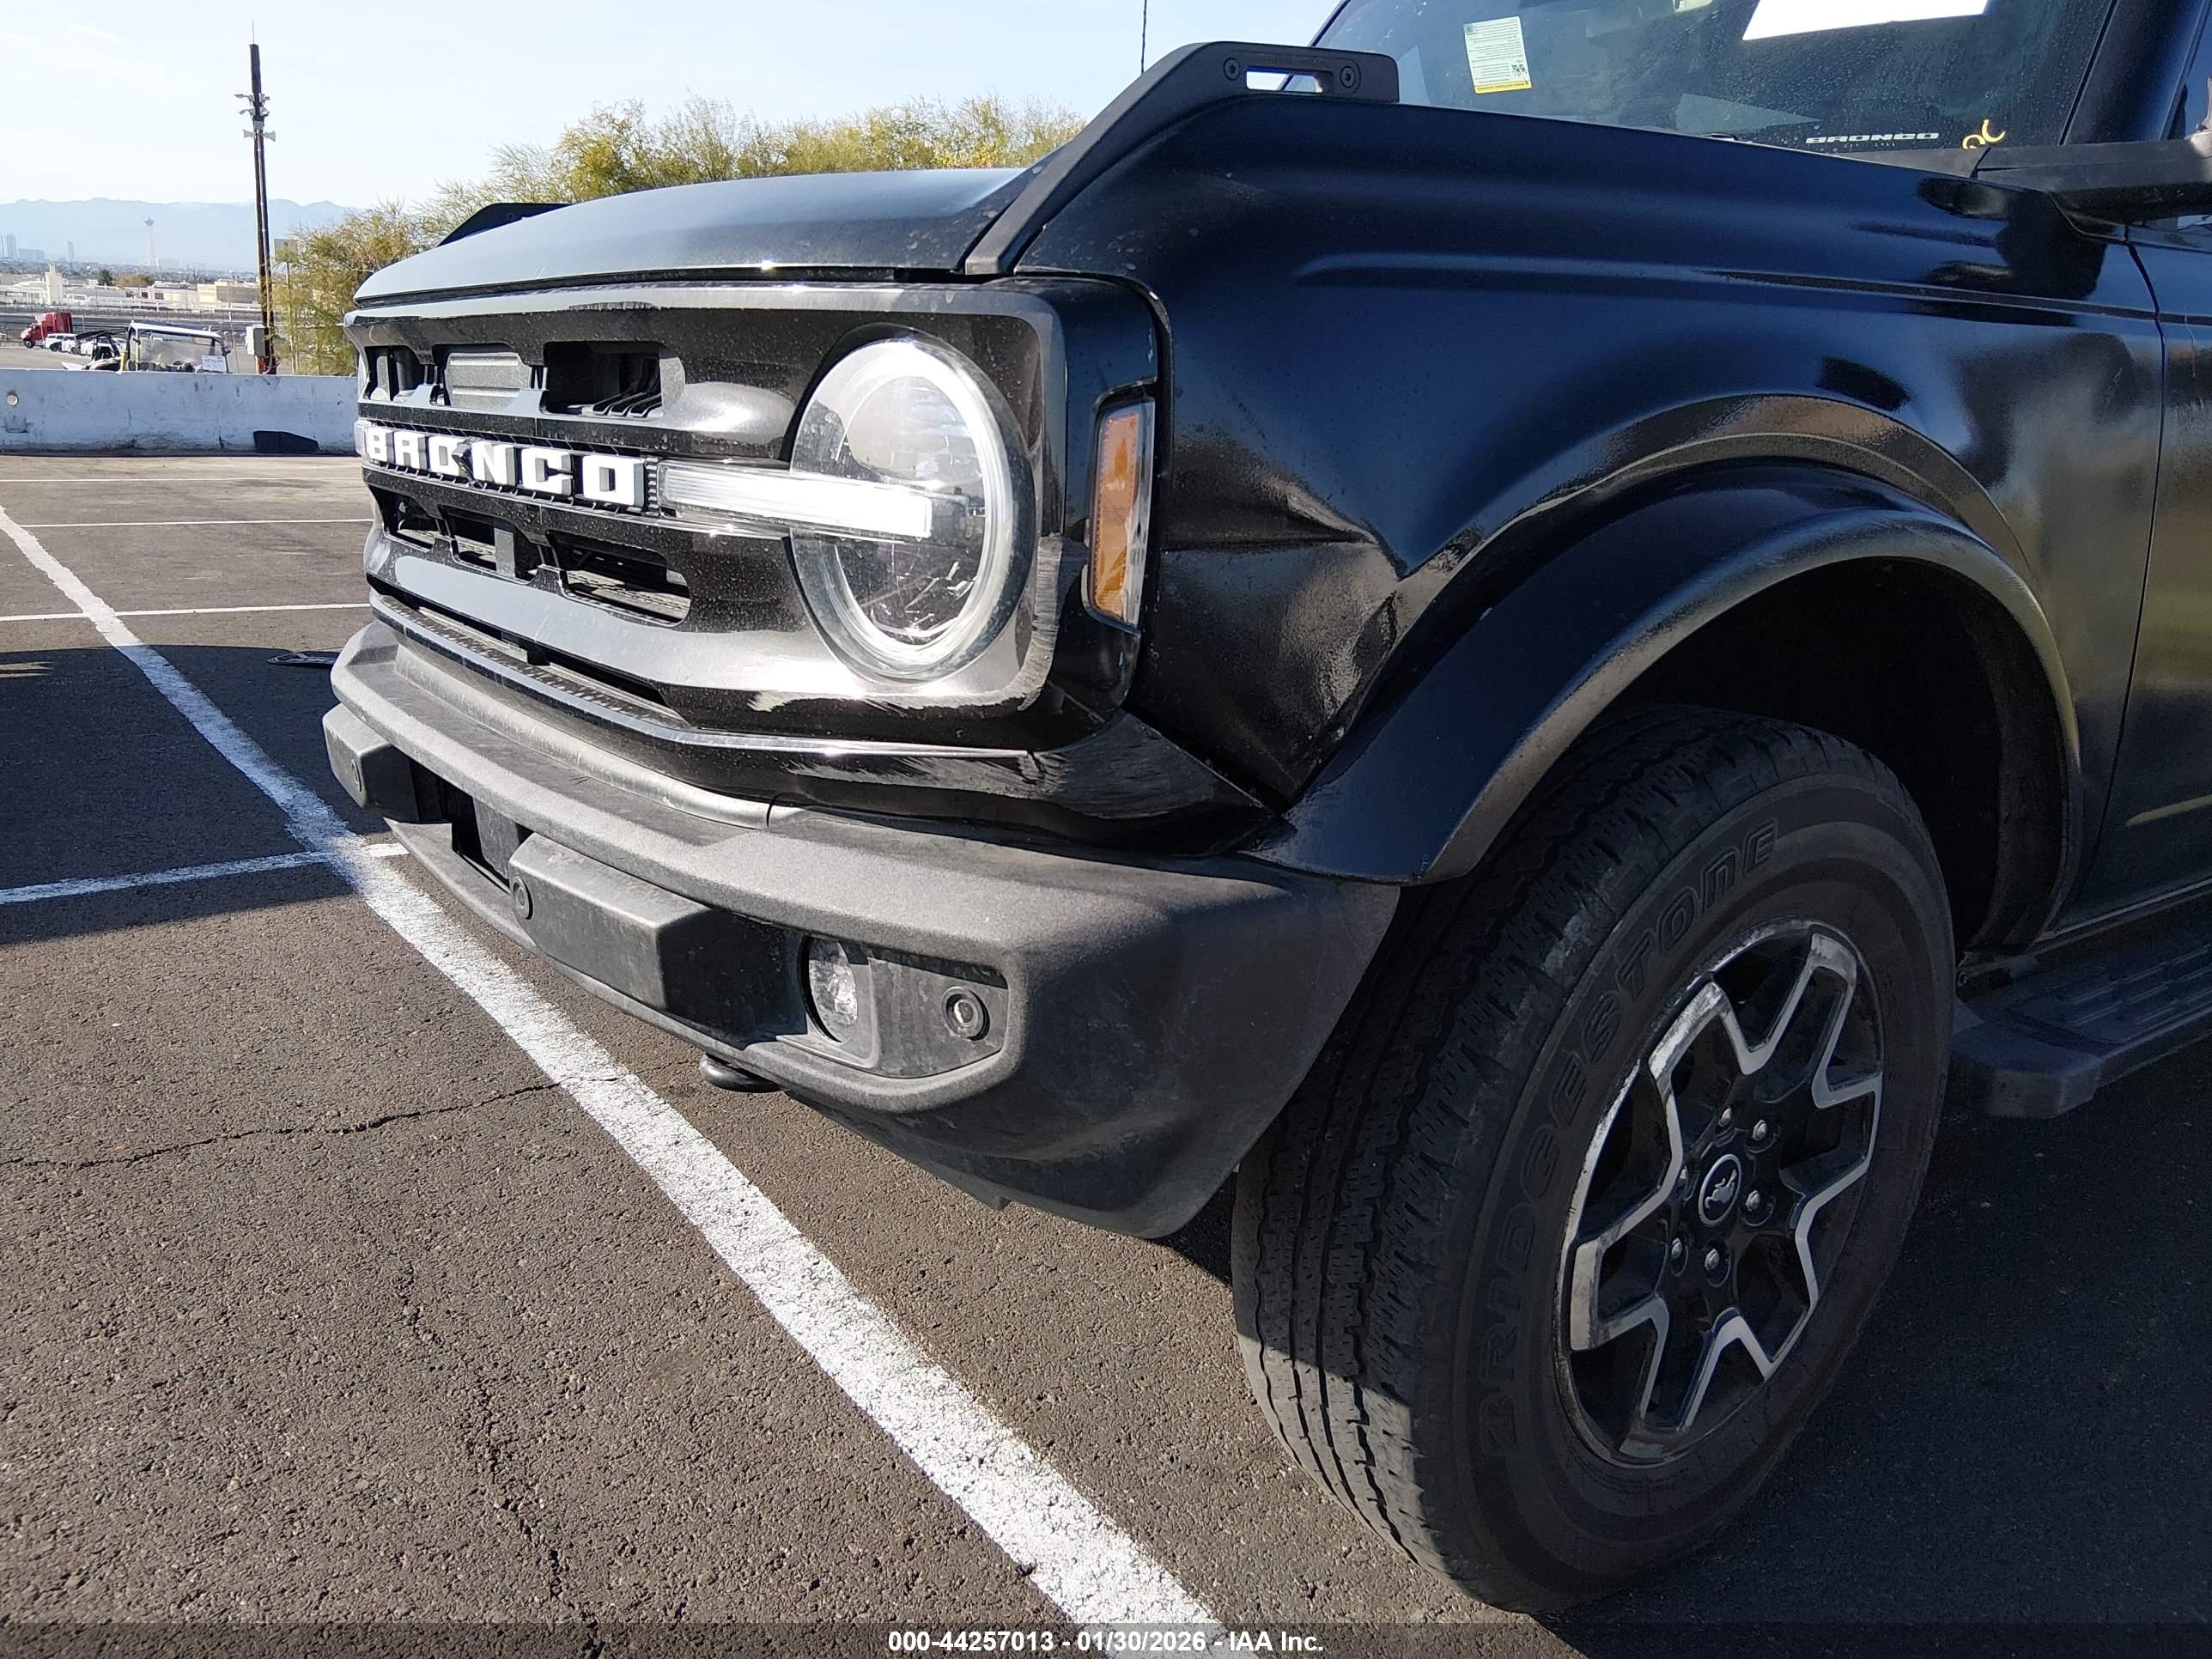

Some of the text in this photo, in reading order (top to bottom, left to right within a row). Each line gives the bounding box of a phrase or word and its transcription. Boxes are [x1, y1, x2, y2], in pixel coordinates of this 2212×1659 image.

[1805, 132, 1940, 144] BRONCO
[364, 425, 646, 507] BRONCO
[1476, 817, 1779, 1455] BRIDGESTONE
